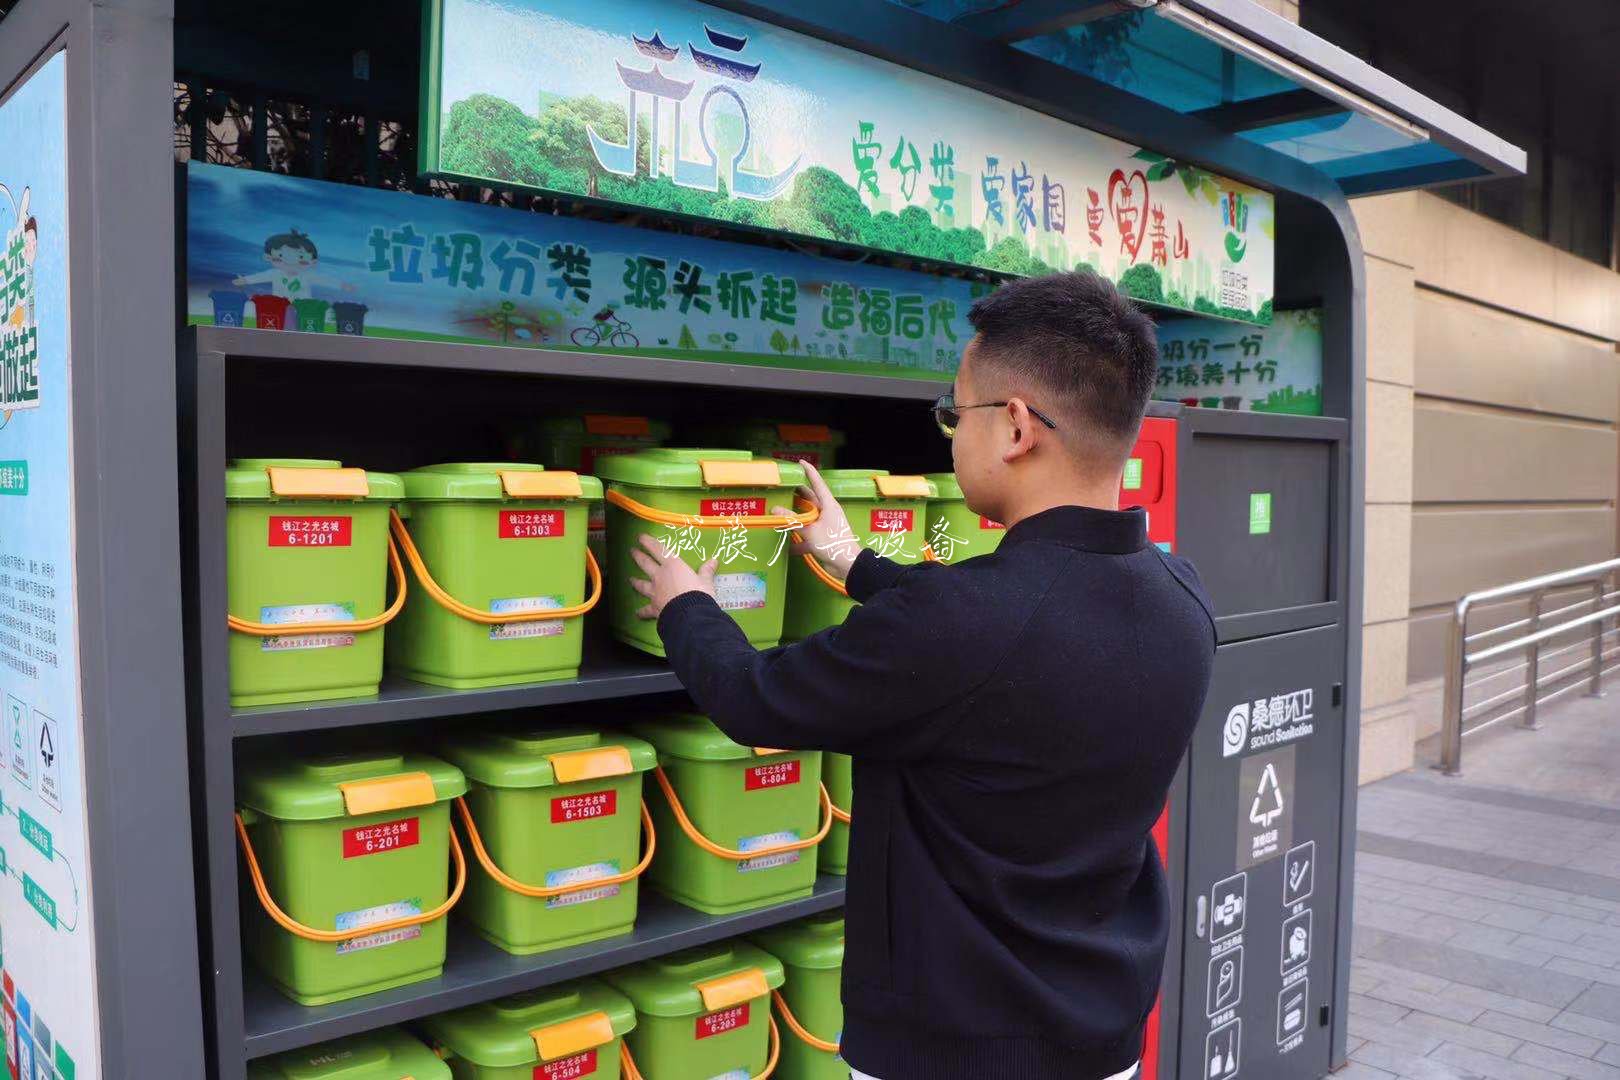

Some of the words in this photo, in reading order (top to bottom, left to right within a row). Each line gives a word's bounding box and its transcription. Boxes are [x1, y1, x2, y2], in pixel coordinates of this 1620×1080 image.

[368, 222, 593, 304] 垃圾分类
[623, 254, 799, 326] 源头抓起
[820, 281, 958, 345] 造福后代
[711, 501, 758, 512] 钱江之光名城
[282, 521, 340, 533] 钱江之光名城
[509, 513, 555, 525] 钱江之光名城
[288, 533, 334, 545] 6-1201
[514, 525, 551, 537] 6-1303
[1251, 688, 1313, 732] 桑德环卫
[561, 793, 608, 810] 钱江之光名城
[565, 804, 602, 820] 6-1503
[355, 822, 409, 842] 钱江之光名城
[366, 836, 400, 852] 6-201
[710, 1017, 736, 1034] 6-203
